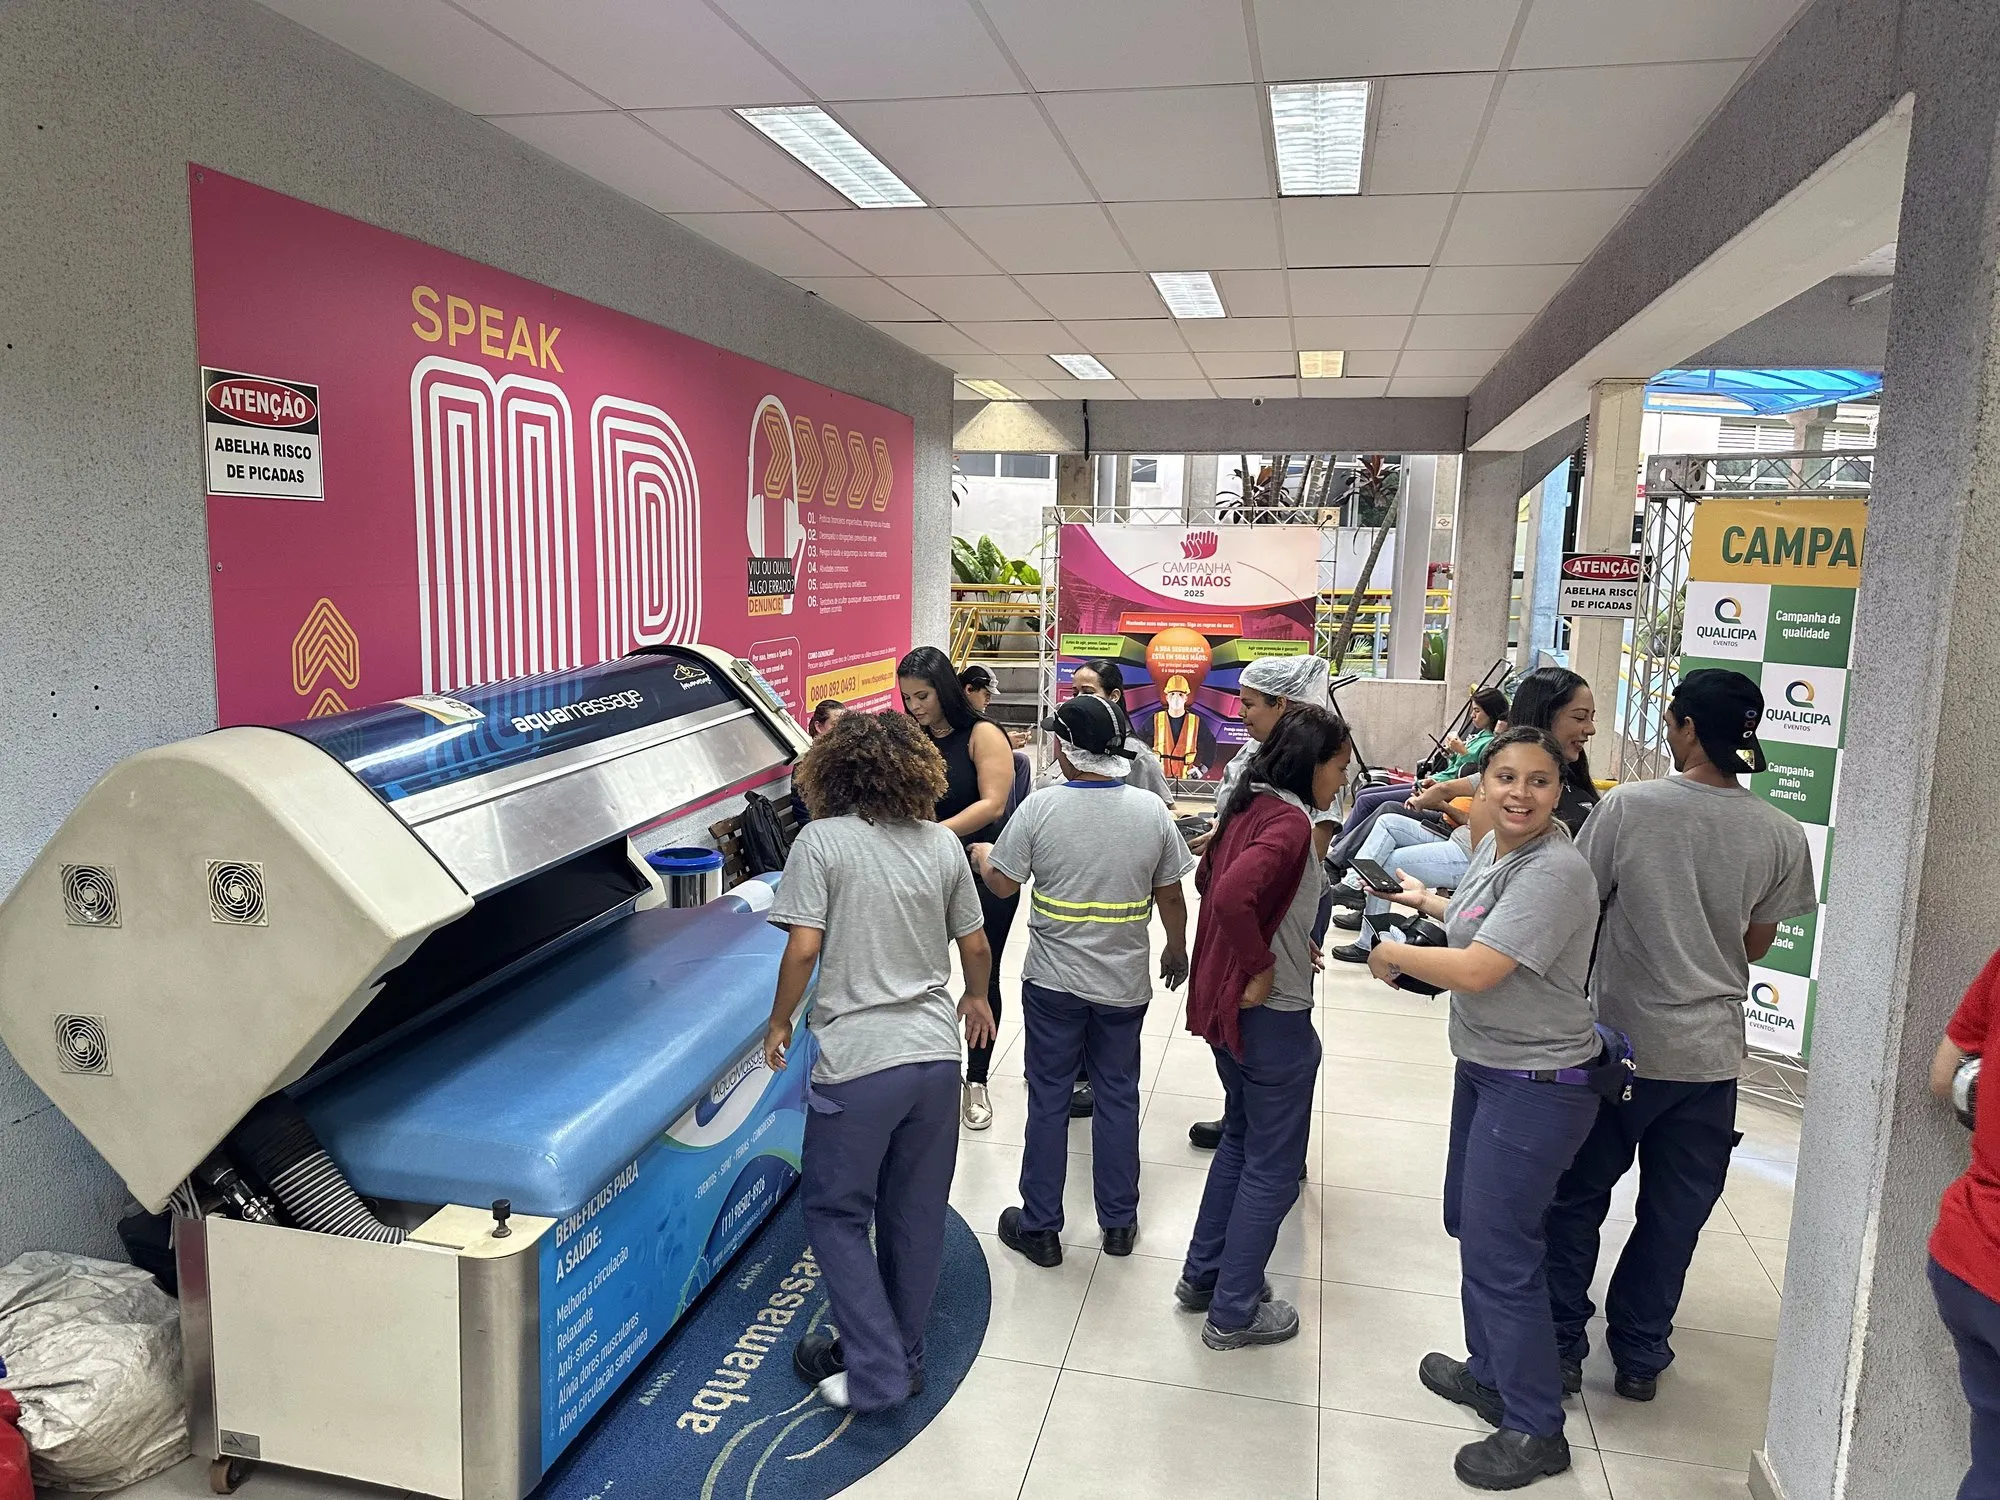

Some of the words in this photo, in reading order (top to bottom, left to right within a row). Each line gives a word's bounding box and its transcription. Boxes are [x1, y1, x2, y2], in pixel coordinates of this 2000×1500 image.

[411, 284, 565, 374] SPEAK
[219, 385, 307, 421] ATENÇÃO
[215, 437, 270, 456] ABELHA
[274, 441, 312, 460] RISCO
[227, 463, 246, 479] DE
[248, 465, 305, 483] PICADAS
[807, 529, 817, 540] 02.
[807, 545, 818, 557] 03.
[1721, 525, 1866, 568] CAMPA
[748, 561, 760, 575] VIU
[762, 561, 772, 575] OU
[772, 561, 791, 575] OUVIU
[807, 562, 818, 573] 04.
[1162, 561, 1232, 574] CAMPANHA
[1571, 560, 1640, 576] ATENÇÃO
[749, 580, 768, 594] ALGO
[768, 579, 794, 593] ERRADO?
[807, 578, 818, 590] 05.
[1162, 575, 1188, 586] DAS
[1192, 573, 1231, 587] MÃOS
[1565, 587, 1606, 596] ABELHA
[749, 597, 784, 613] DENUNCIE!
[807, 596, 818, 607] 06.
[1571, 600, 1585, 608] DE
[1588, 601, 1632, 610] PICADAS
[1775, 610, 1826, 624] Campanha
[1828, 612, 1841, 625] da
[1696, 626, 1757, 641] QUALICIPA
[1782, 628, 1830, 640] qualidade
[810, 684, 828, 701] 0800
[829, 681, 840, 697] 892
[840, 676, 856, 693] 0493
[511, 688, 644, 734] aquamassage
[1765, 708, 1831, 726] QUALICIPA
[1784, 724, 1811, 732] EVENTOS
[1768, 762, 1814, 778] Campanha
[1778, 777, 1800, 788] maio
[1770, 788, 1806, 802] amarelo
[1792, 922, 1804, 937] da
[713, 1047, 766, 1098] AquaMassag
[614, 1160, 639, 1197] PARA
[556, 1259, 564, 1284] A
[566, 1225, 602, 1273] SAÚDE:
[557, 1286, 587, 1326] Melhora
[588, 1280, 593, 1295] a
[594, 1246, 628, 1289] circulação
[557, 1307, 594, 1354] Relaxante
[676, 1245, 822, 1434] aquamassa
[558, 1330, 598, 1381] Anti-stress
[559, 1375, 579, 1409] Alivia
[580, 1354, 600, 1384] dores
[600, 1311, 639, 1362] musculares
[559, 1405, 578, 1436] Ativa
[578, 1364, 614, 1412] circulação
